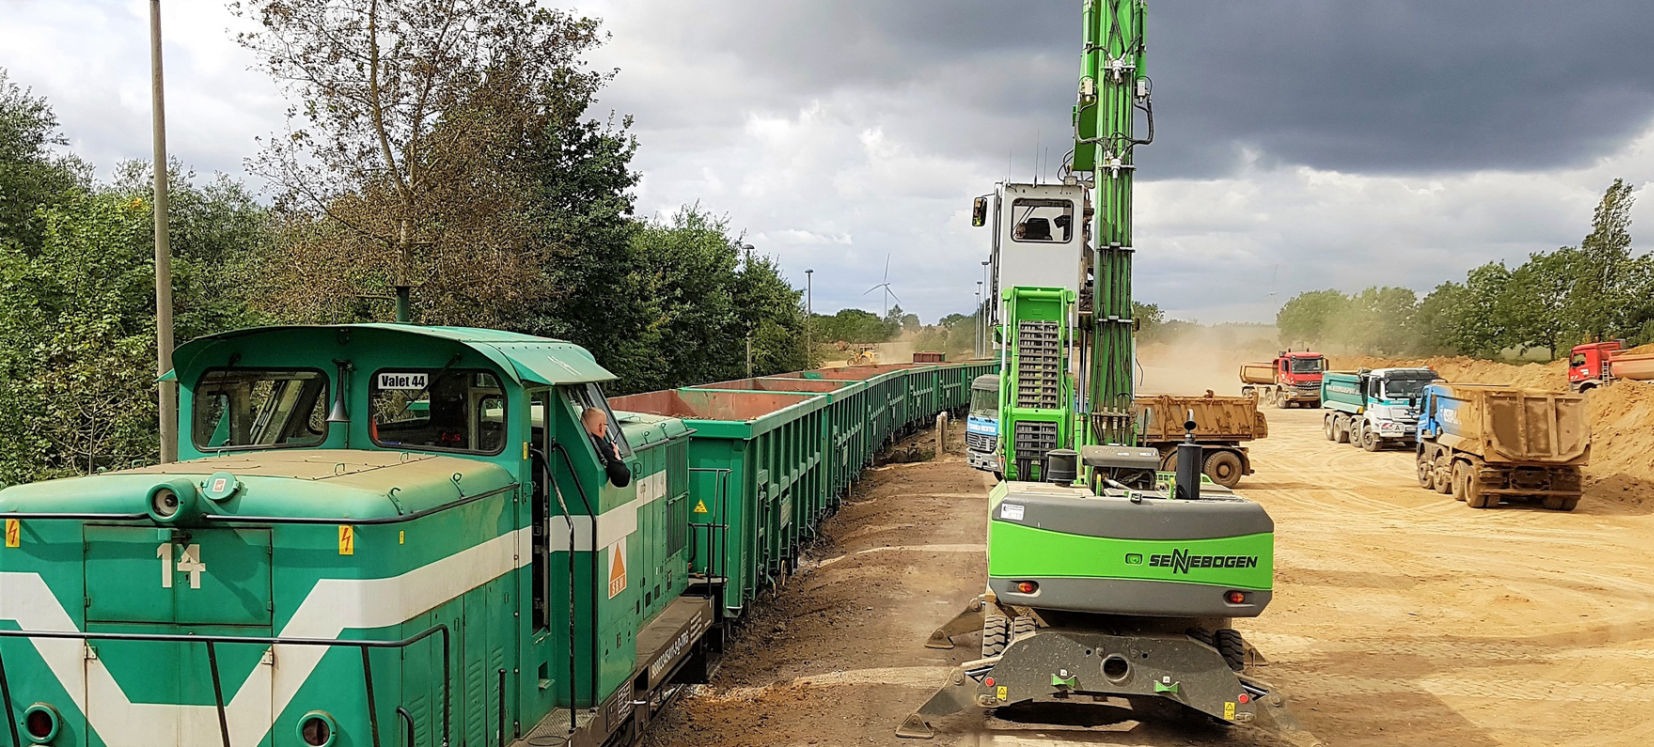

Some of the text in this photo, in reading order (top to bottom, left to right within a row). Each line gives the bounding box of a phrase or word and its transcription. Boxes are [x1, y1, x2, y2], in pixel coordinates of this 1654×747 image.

[382, 376, 425, 387] Valet 44
[157, 543, 206, 589] 14
[1149, 548, 1258, 574] SENNEBOGEN
